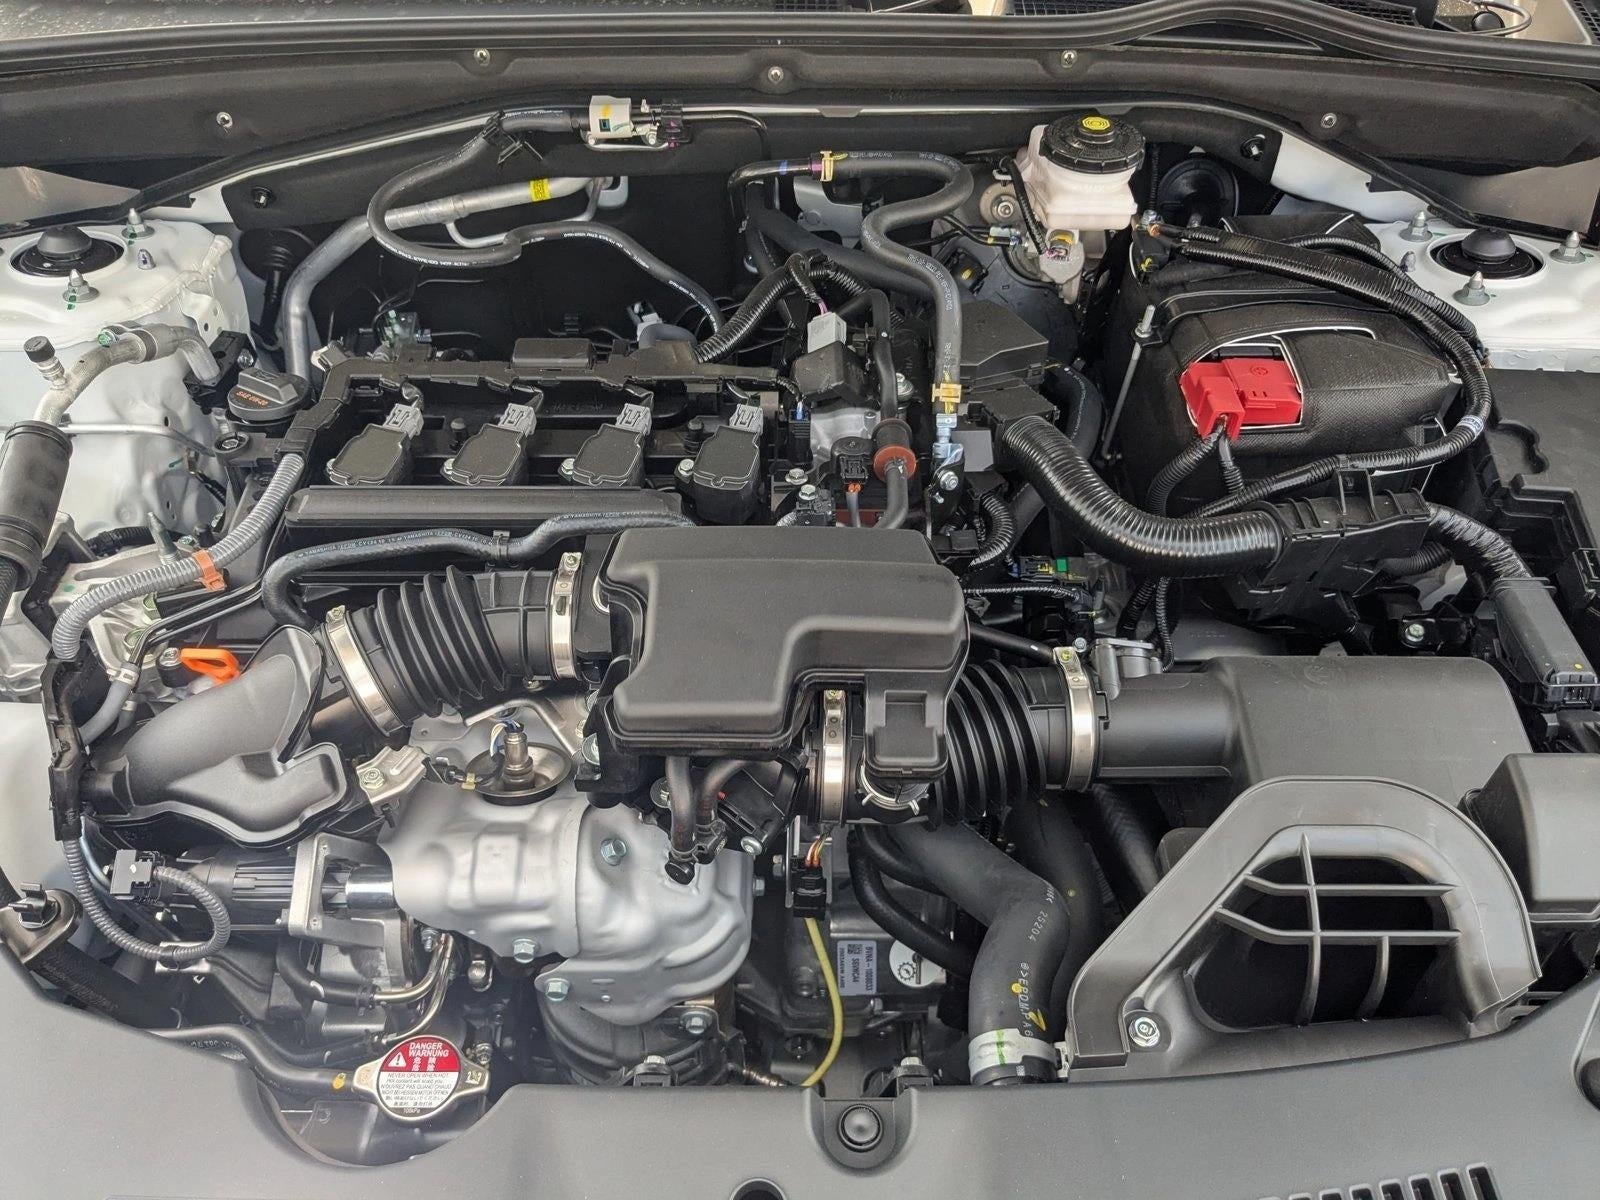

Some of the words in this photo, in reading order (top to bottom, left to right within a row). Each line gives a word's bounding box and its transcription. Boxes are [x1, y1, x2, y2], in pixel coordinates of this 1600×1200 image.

[1028, 910, 1048, 942] 25204
[409, 1042, 443, 1050] DANGER
[408, 1049, 450, 1057] WARNUNG
